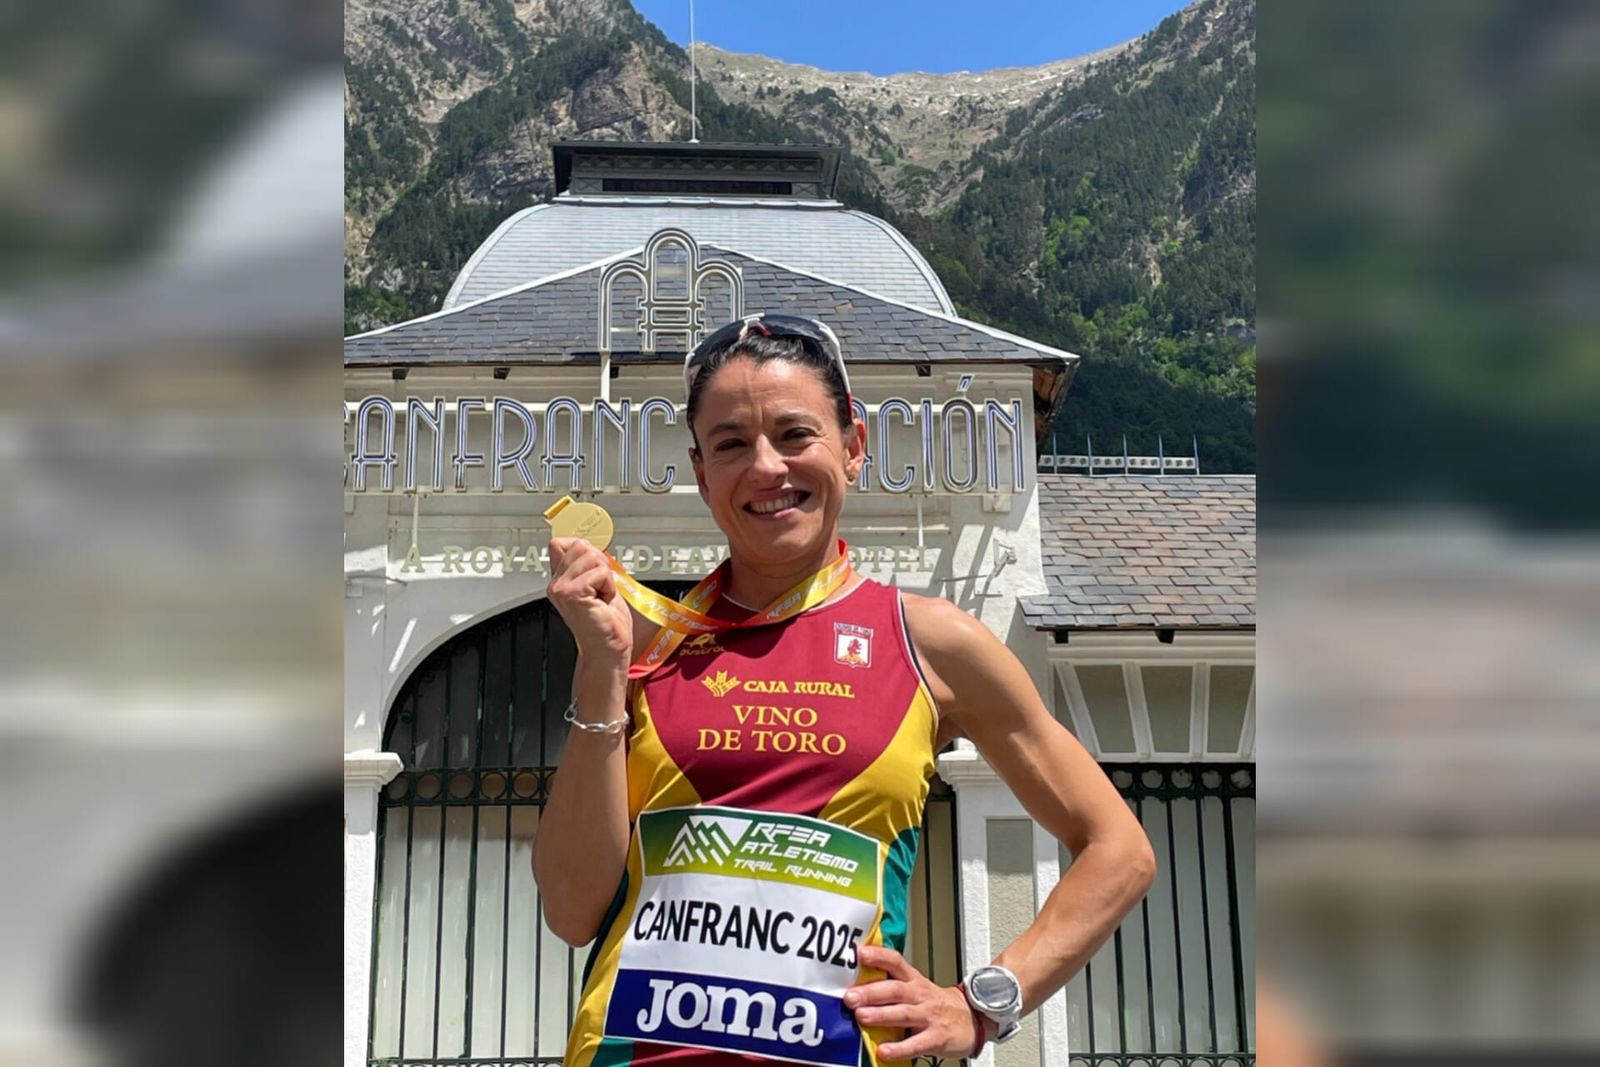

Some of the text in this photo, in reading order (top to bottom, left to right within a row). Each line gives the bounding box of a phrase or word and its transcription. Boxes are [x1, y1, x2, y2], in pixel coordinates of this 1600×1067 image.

[344, 395, 677, 493] ANFRANC
[400, 544, 425, 573] A
[437, 545, 545, 574] ROYA
[743, 680, 856, 699] CAJA RURAL
[732, 705, 818, 728] VINO
[696, 728, 847, 755] DE TORO
[750, 821, 831, 847] RFEA
[739, 840, 859, 874] ATLETISMO
[733, 858, 854, 889] TRAIL RUNNING
[633, 899, 864, 970] CANFRANC 2025
[636, 978, 824, 1047] Joma
